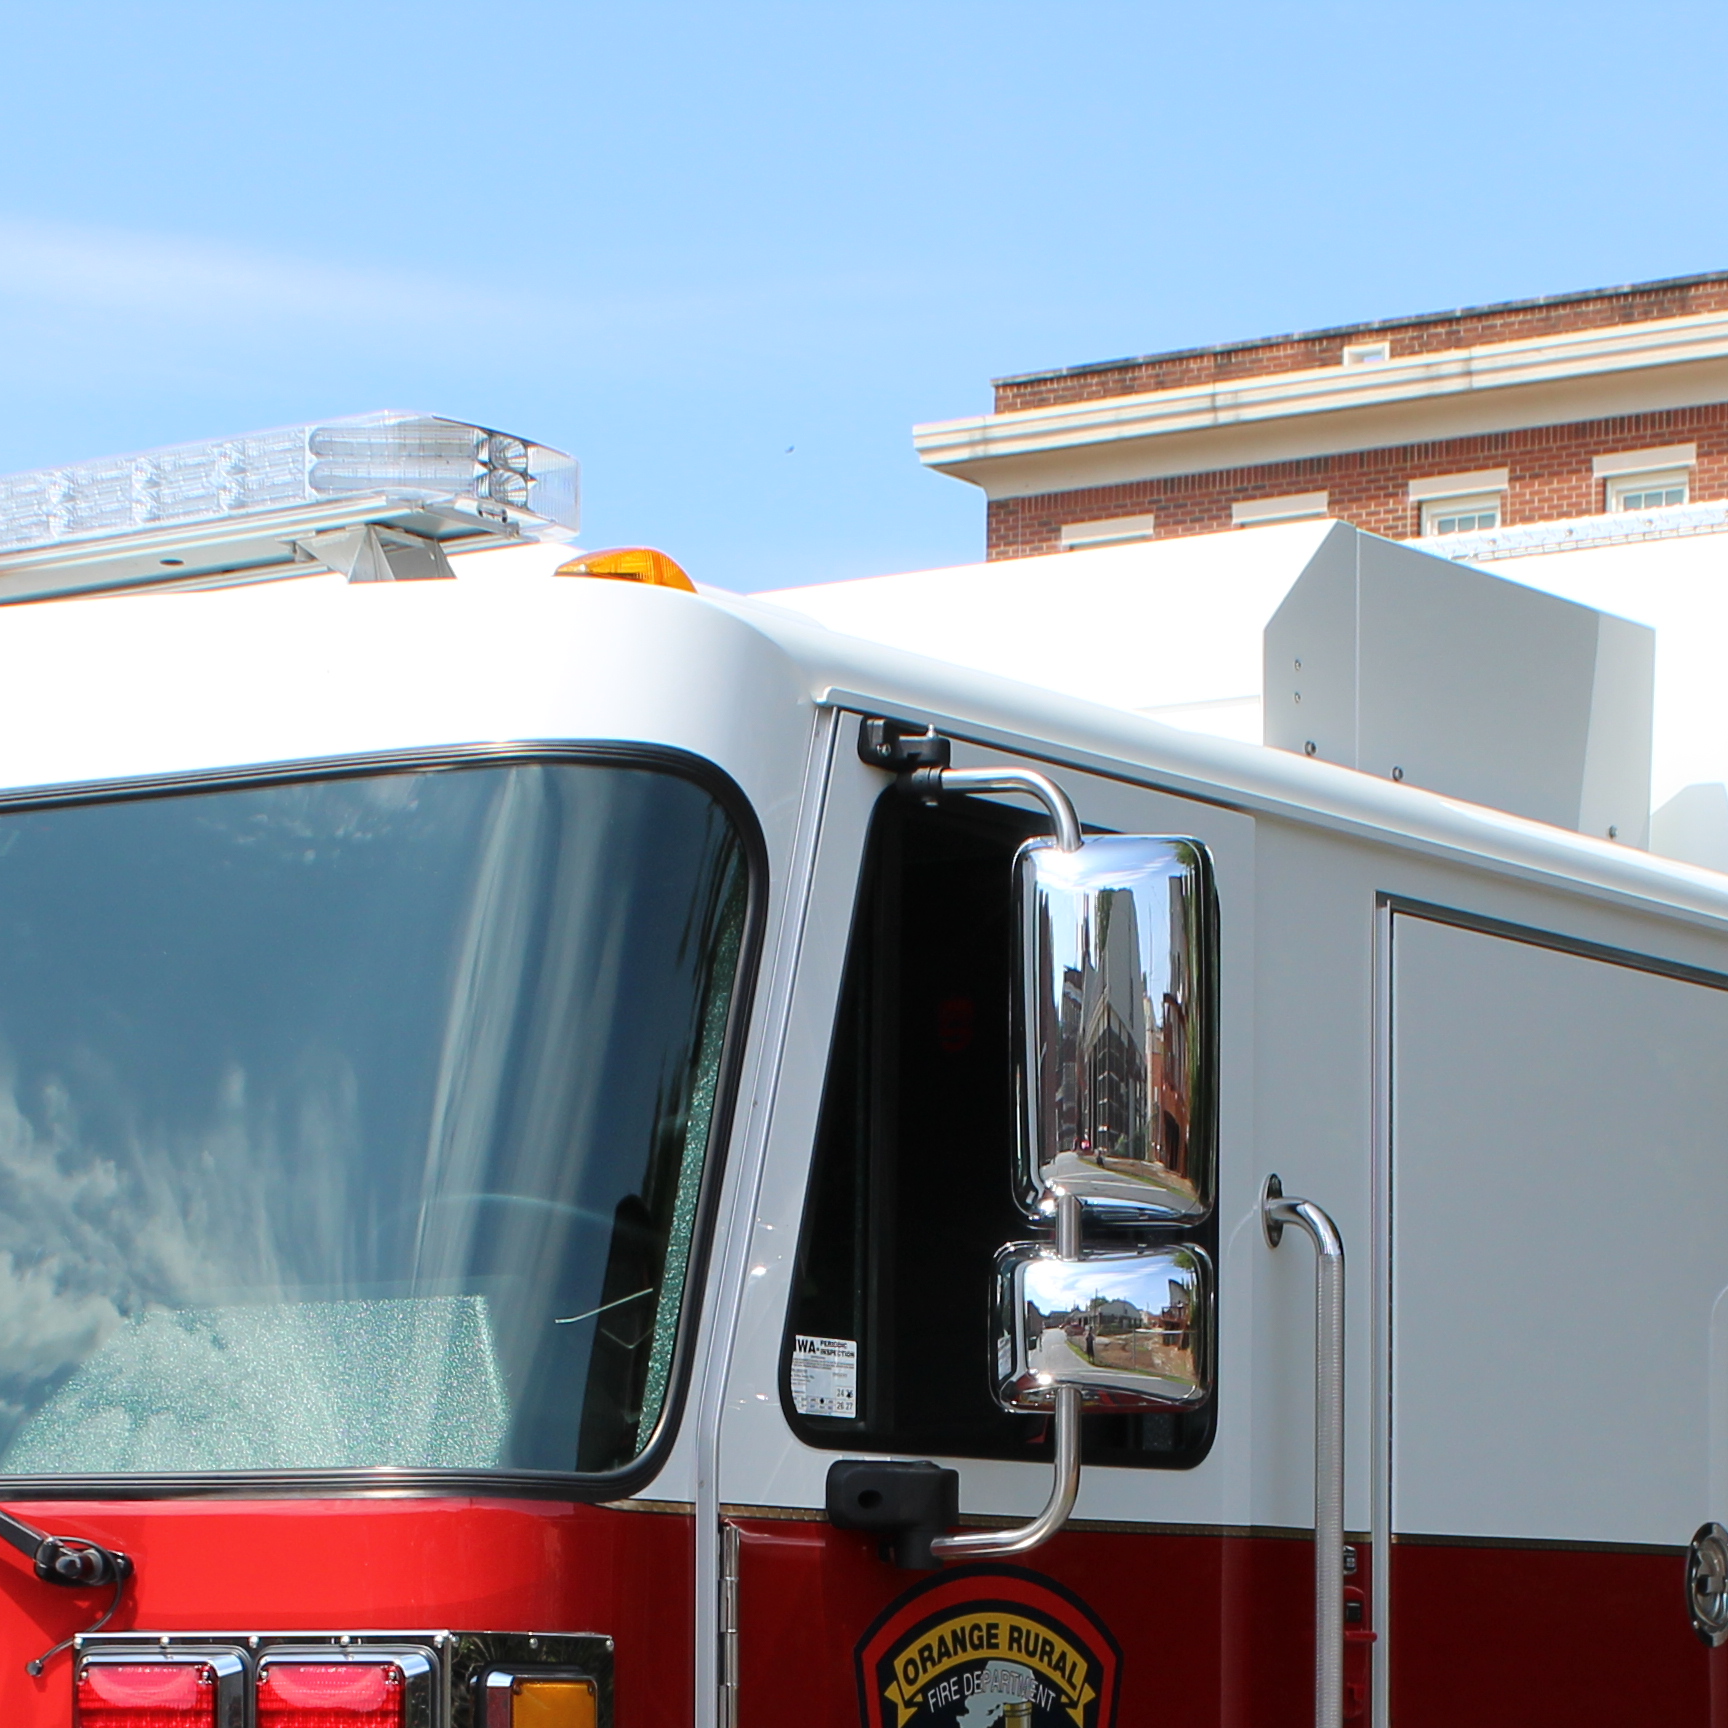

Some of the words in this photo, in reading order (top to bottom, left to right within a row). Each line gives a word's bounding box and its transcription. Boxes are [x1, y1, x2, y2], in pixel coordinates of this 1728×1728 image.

[902, 1622, 1000, 1687] ORANGE
[1008, 1624, 1083, 1692] RURAL
[927, 1676, 960, 1713] FIRE
[963, 1669, 1056, 1712] DEPARTMENT
